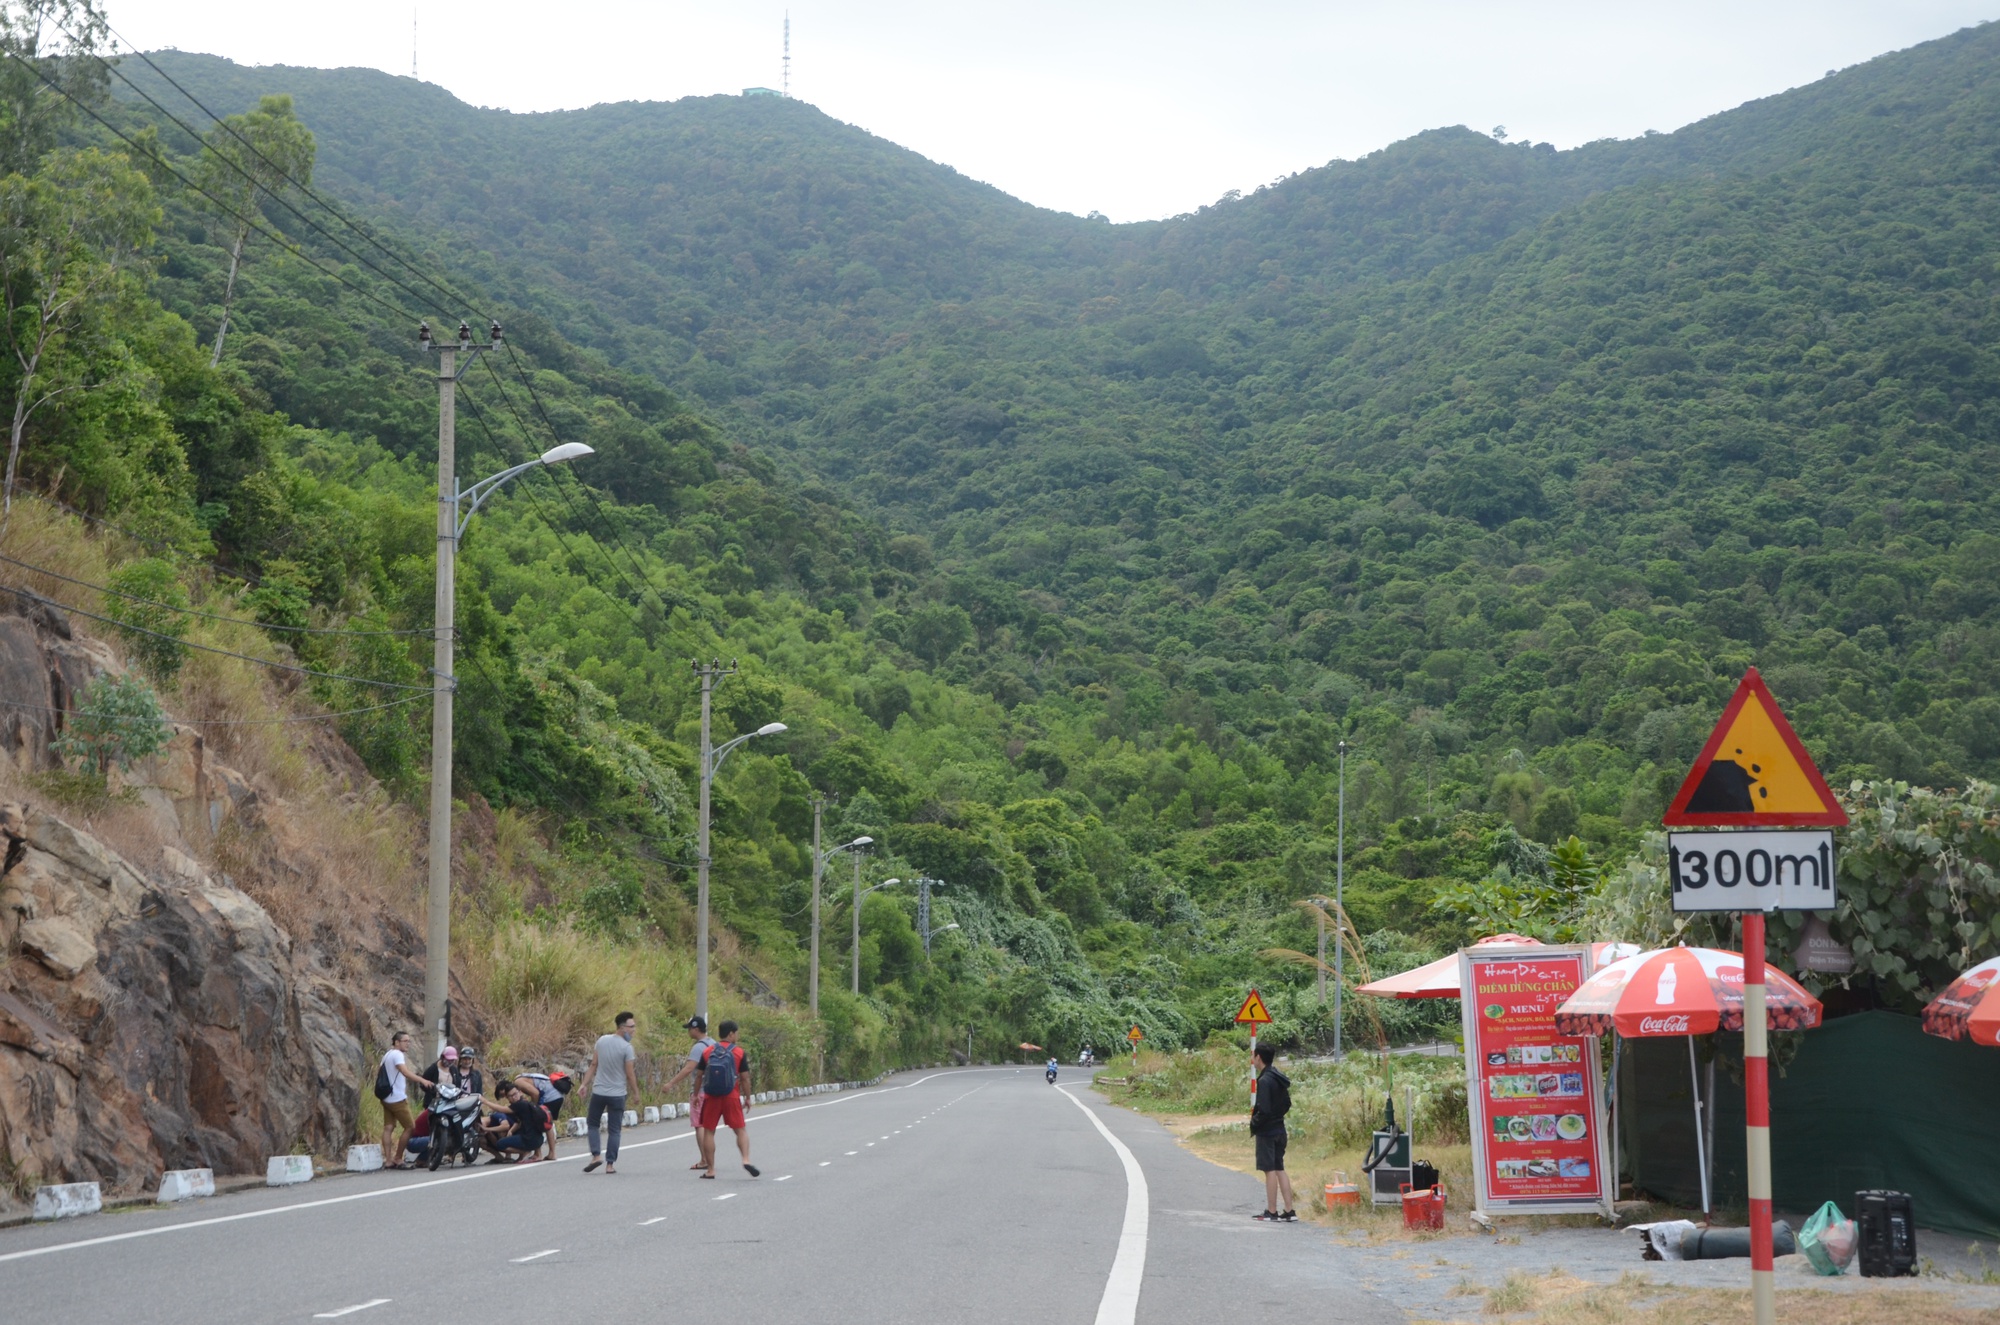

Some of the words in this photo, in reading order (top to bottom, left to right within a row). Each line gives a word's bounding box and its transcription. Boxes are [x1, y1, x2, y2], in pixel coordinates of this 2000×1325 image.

[1682, 849, 1820, 889] 300m
[1720, 973, 1745, 983] Coca-C
[1543, 979, 1575, 992] CHÂN
[1511, 1004, 1545, 1014] MENU
[1640, 1015, 1690, 1033] Coca-Cola
